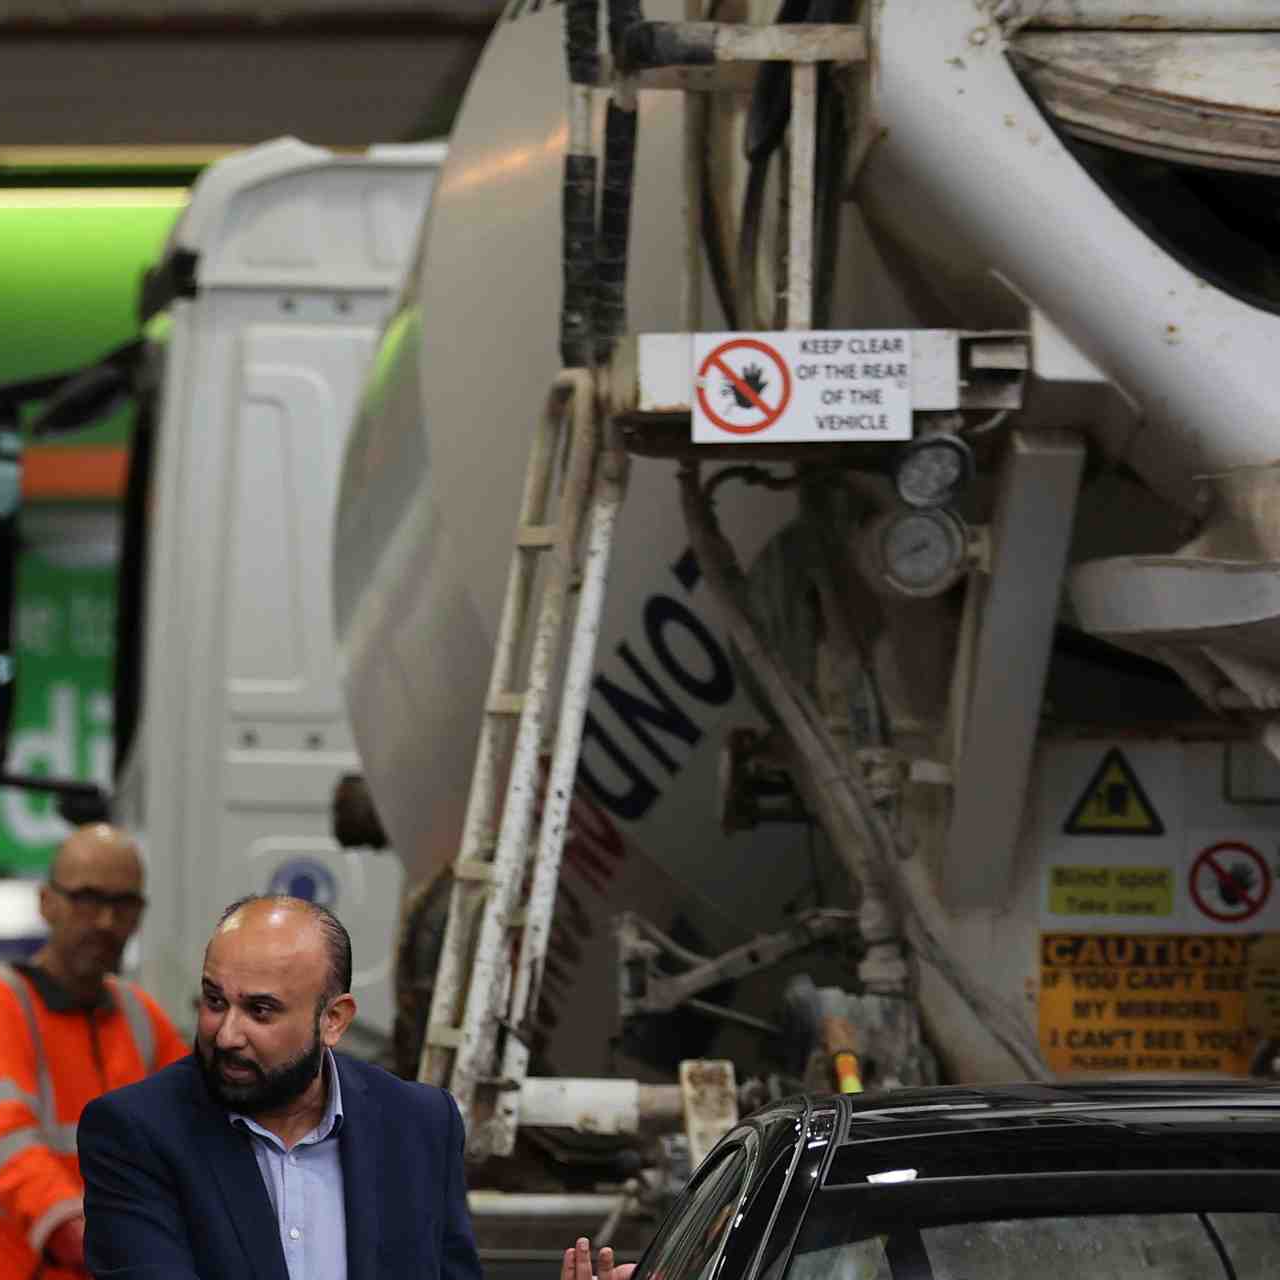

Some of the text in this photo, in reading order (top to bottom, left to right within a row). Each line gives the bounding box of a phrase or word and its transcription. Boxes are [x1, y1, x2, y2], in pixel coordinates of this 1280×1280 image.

[800, 338, 904, 354] KEEP CLEAR
[797, 363, 908, 380] OF THE REAR
[821, 389, 882, 405] OF THE
[815, 414, 889, 430] VEHICLE
[1045, 937, 1247, 964] CAUTION
[1072, 970, 1120, 989] YOU
